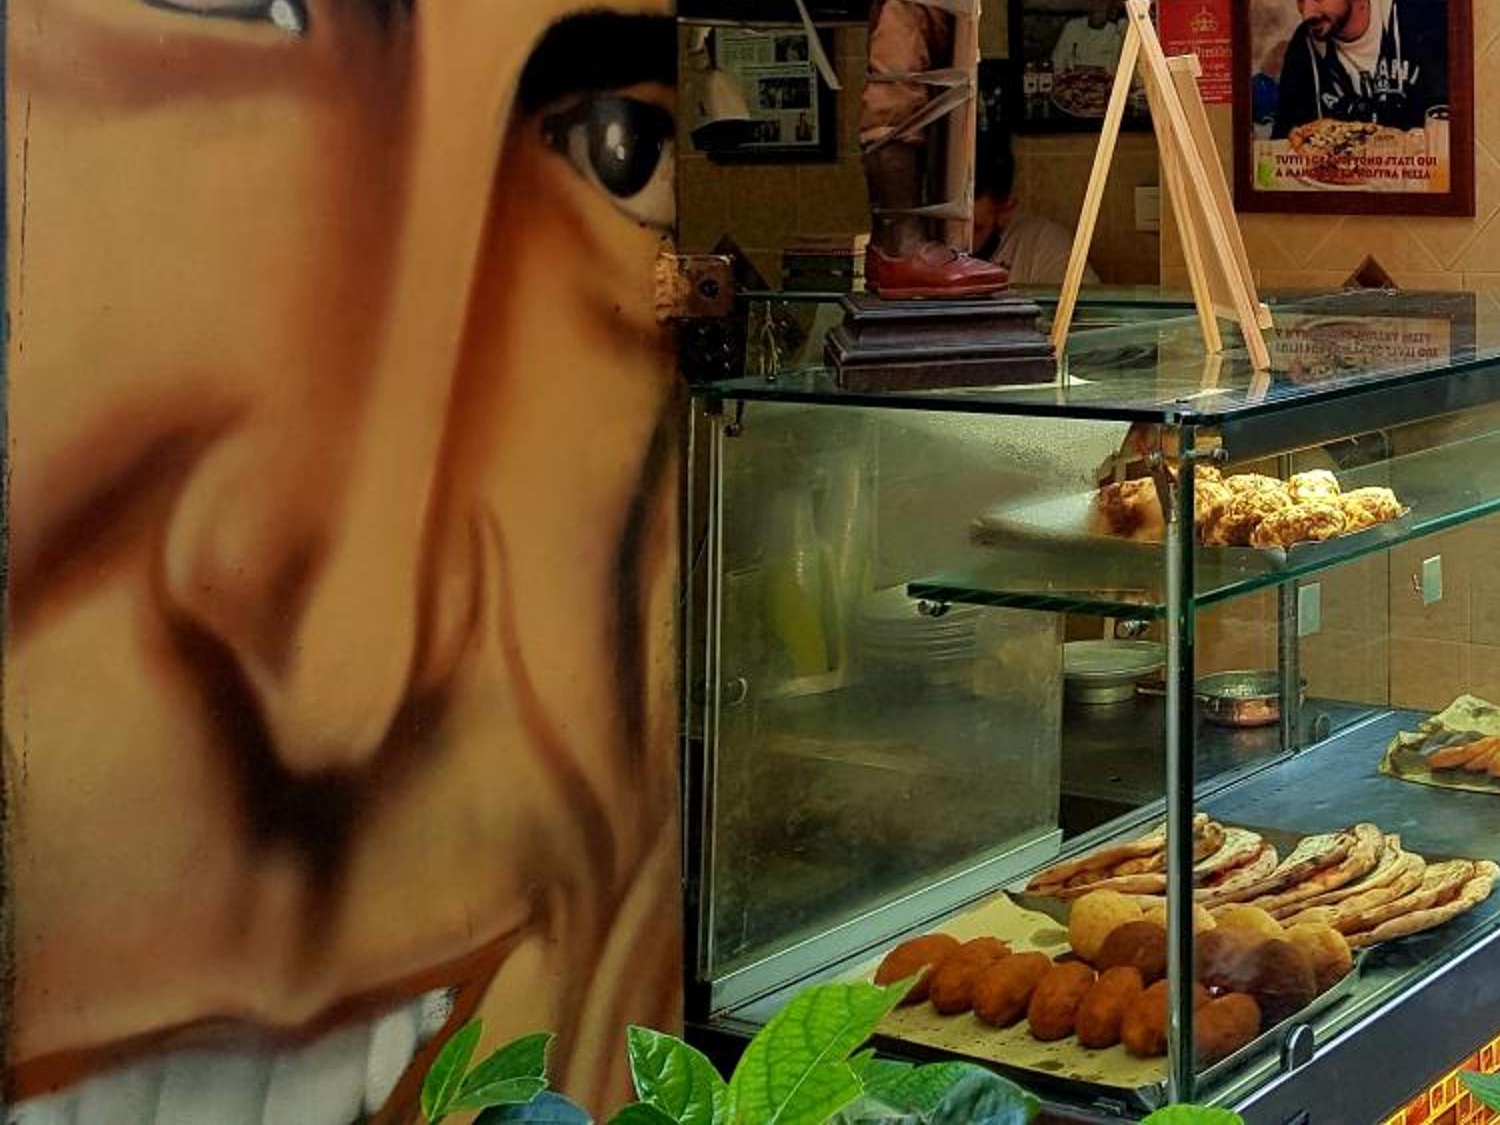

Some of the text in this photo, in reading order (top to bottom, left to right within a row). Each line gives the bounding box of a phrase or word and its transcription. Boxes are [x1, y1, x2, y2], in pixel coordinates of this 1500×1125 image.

[1276, 154, 1303, 166] TUTTI
[1385, 155, 1414, 166] STATI
[1417, 155, 1437, 167] QUI
